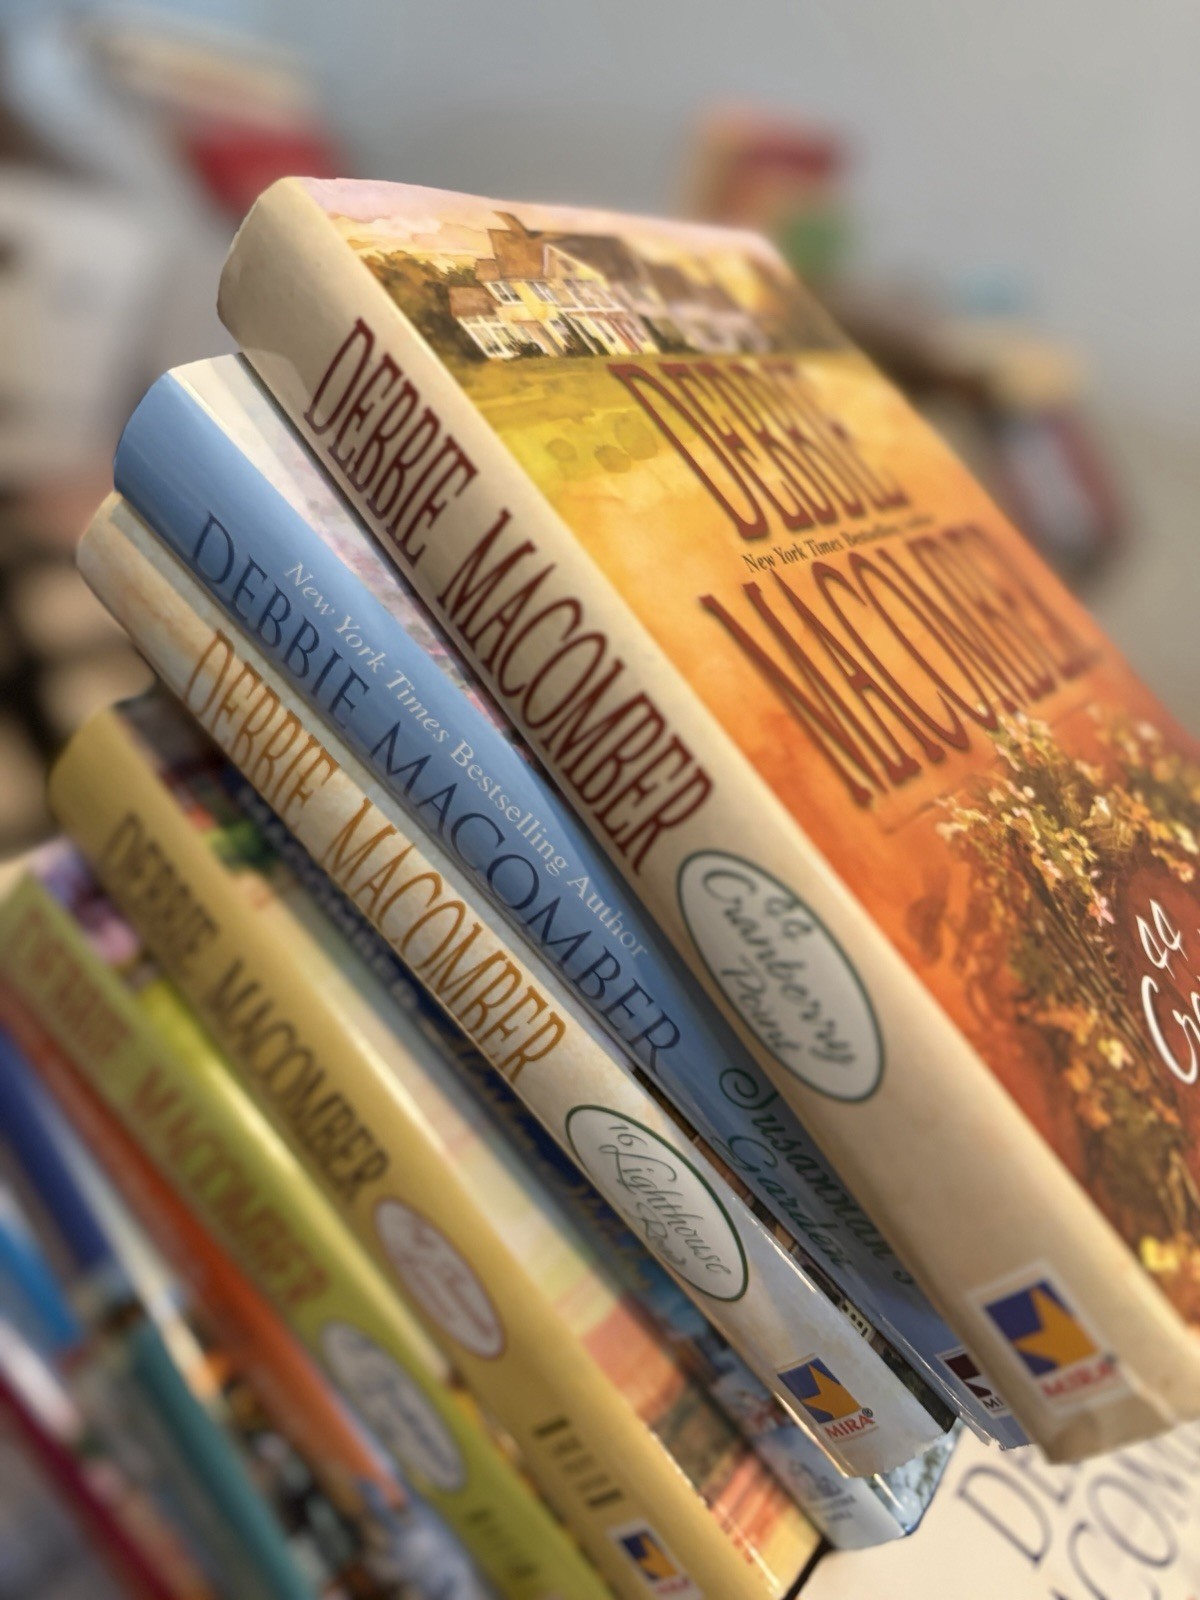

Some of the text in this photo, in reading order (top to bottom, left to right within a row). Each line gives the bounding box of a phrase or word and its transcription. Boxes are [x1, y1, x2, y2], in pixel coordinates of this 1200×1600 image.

[606, 362, 909, 540] DEBBIE
[304, 317, 714, 874] DEBBIE MACOMBER
[742, 550, 775, 574] New
[773, 543, 808, 565] York
[805, 538, 844, 558] Times
[283, 561, 648, 959] New York Times Bestselling Author
[698, 520, 1100, 808] MACOMBER
[184, 629, 341, 825] DEBBIE
[320, 796, 567, 1084] MACOMBER
[187, 511, 371, 730] DEBBIE
[367, 720, 682, 1072] MACOMBER
[703, 869, 855, 1065] Cranberry
[208, 956, 392, 1202] MACOMBER
[608, 1123, 648, 1147] 16
[598, 1143, 732, 1275] Lighthouse
[710, 1134, 852, 1269] Garden
[1040, 1359, 1117, 1398] MIRA
